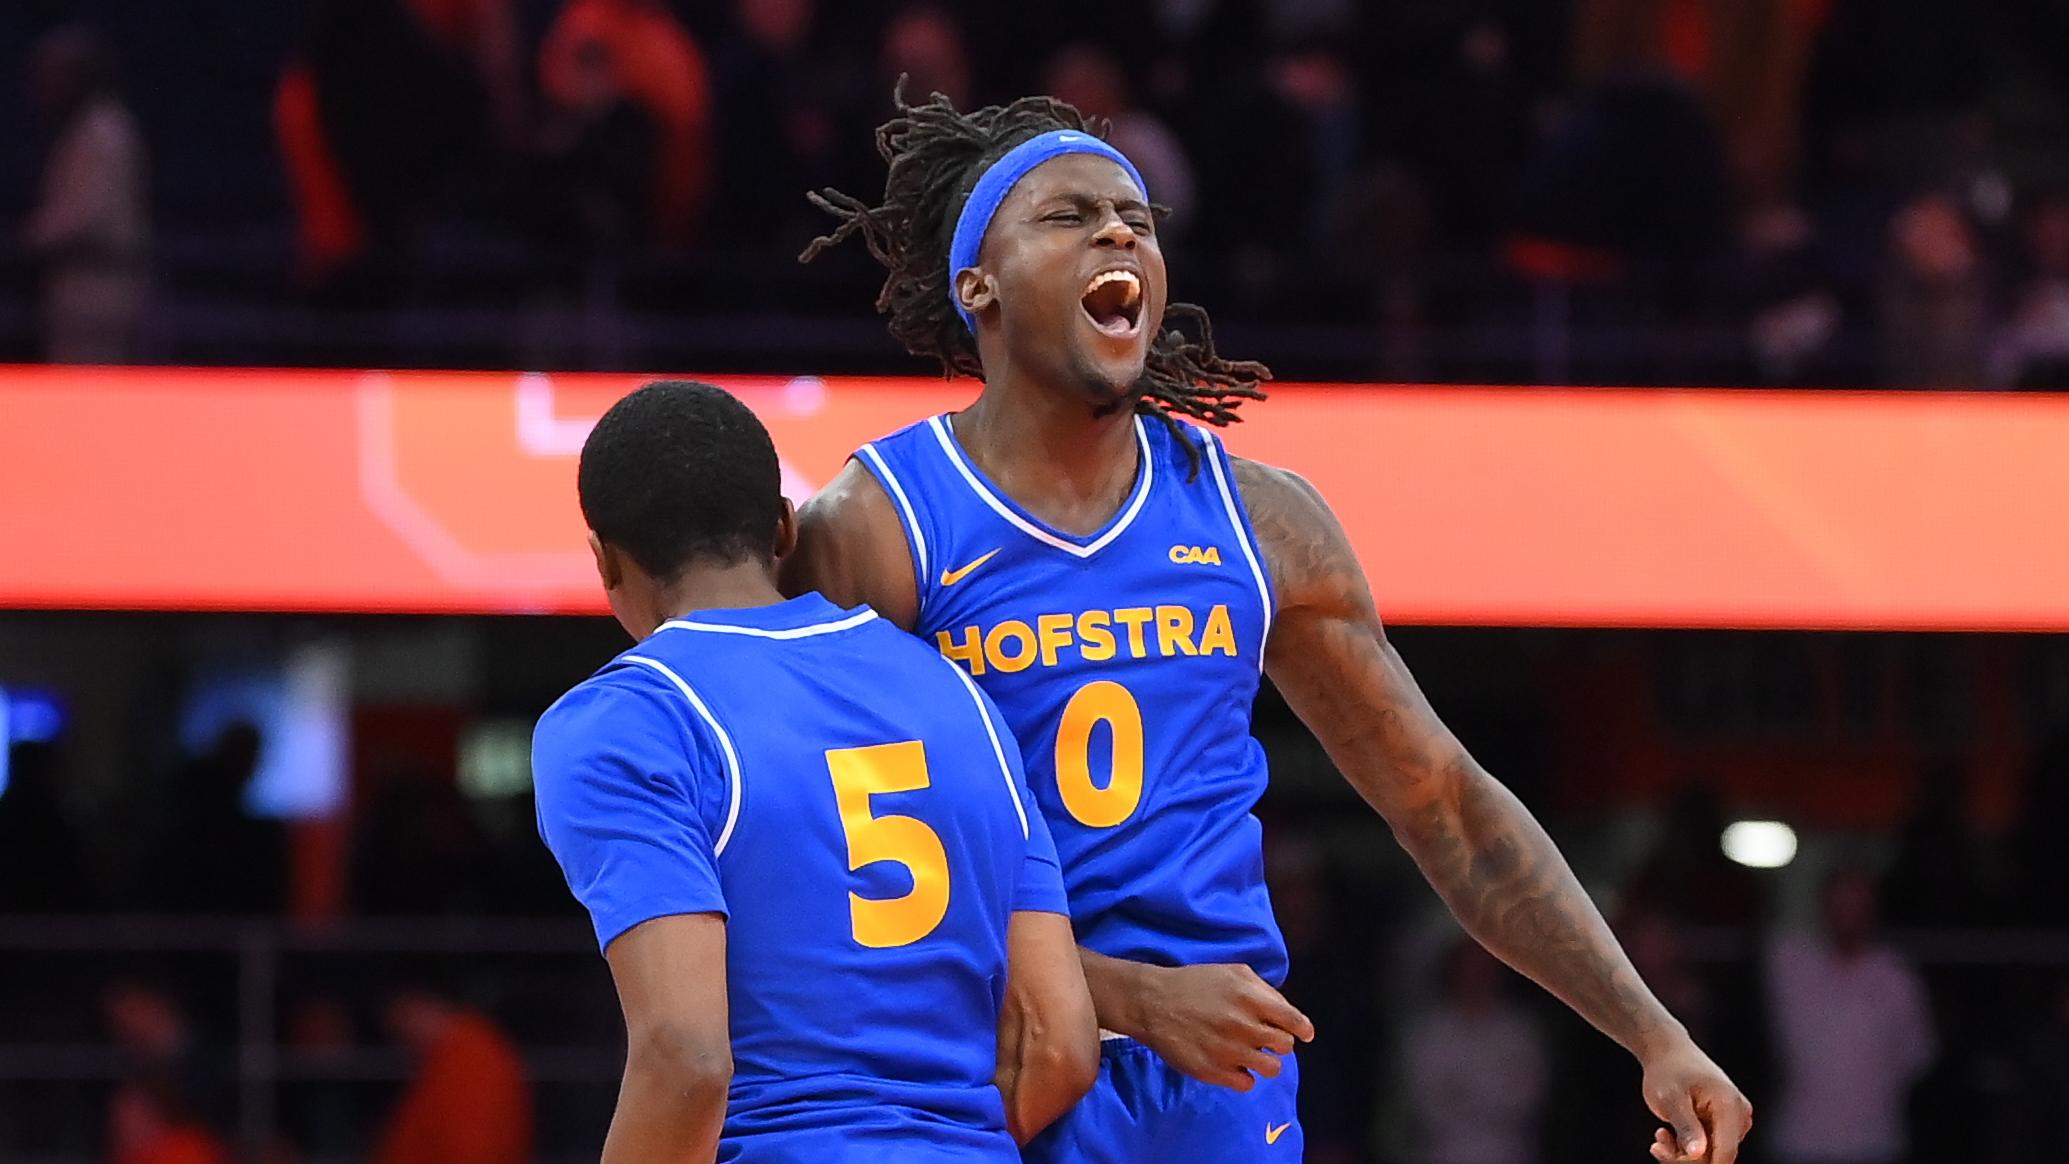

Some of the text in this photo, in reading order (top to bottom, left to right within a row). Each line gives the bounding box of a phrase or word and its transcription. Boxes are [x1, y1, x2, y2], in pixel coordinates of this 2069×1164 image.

[1168, 544, 1222, 567] CAA
[935, 604, 1238, 676] HOFSTRA
[1054, 680, 1144, 828] 0
[825, 739, 951, 949] 5
